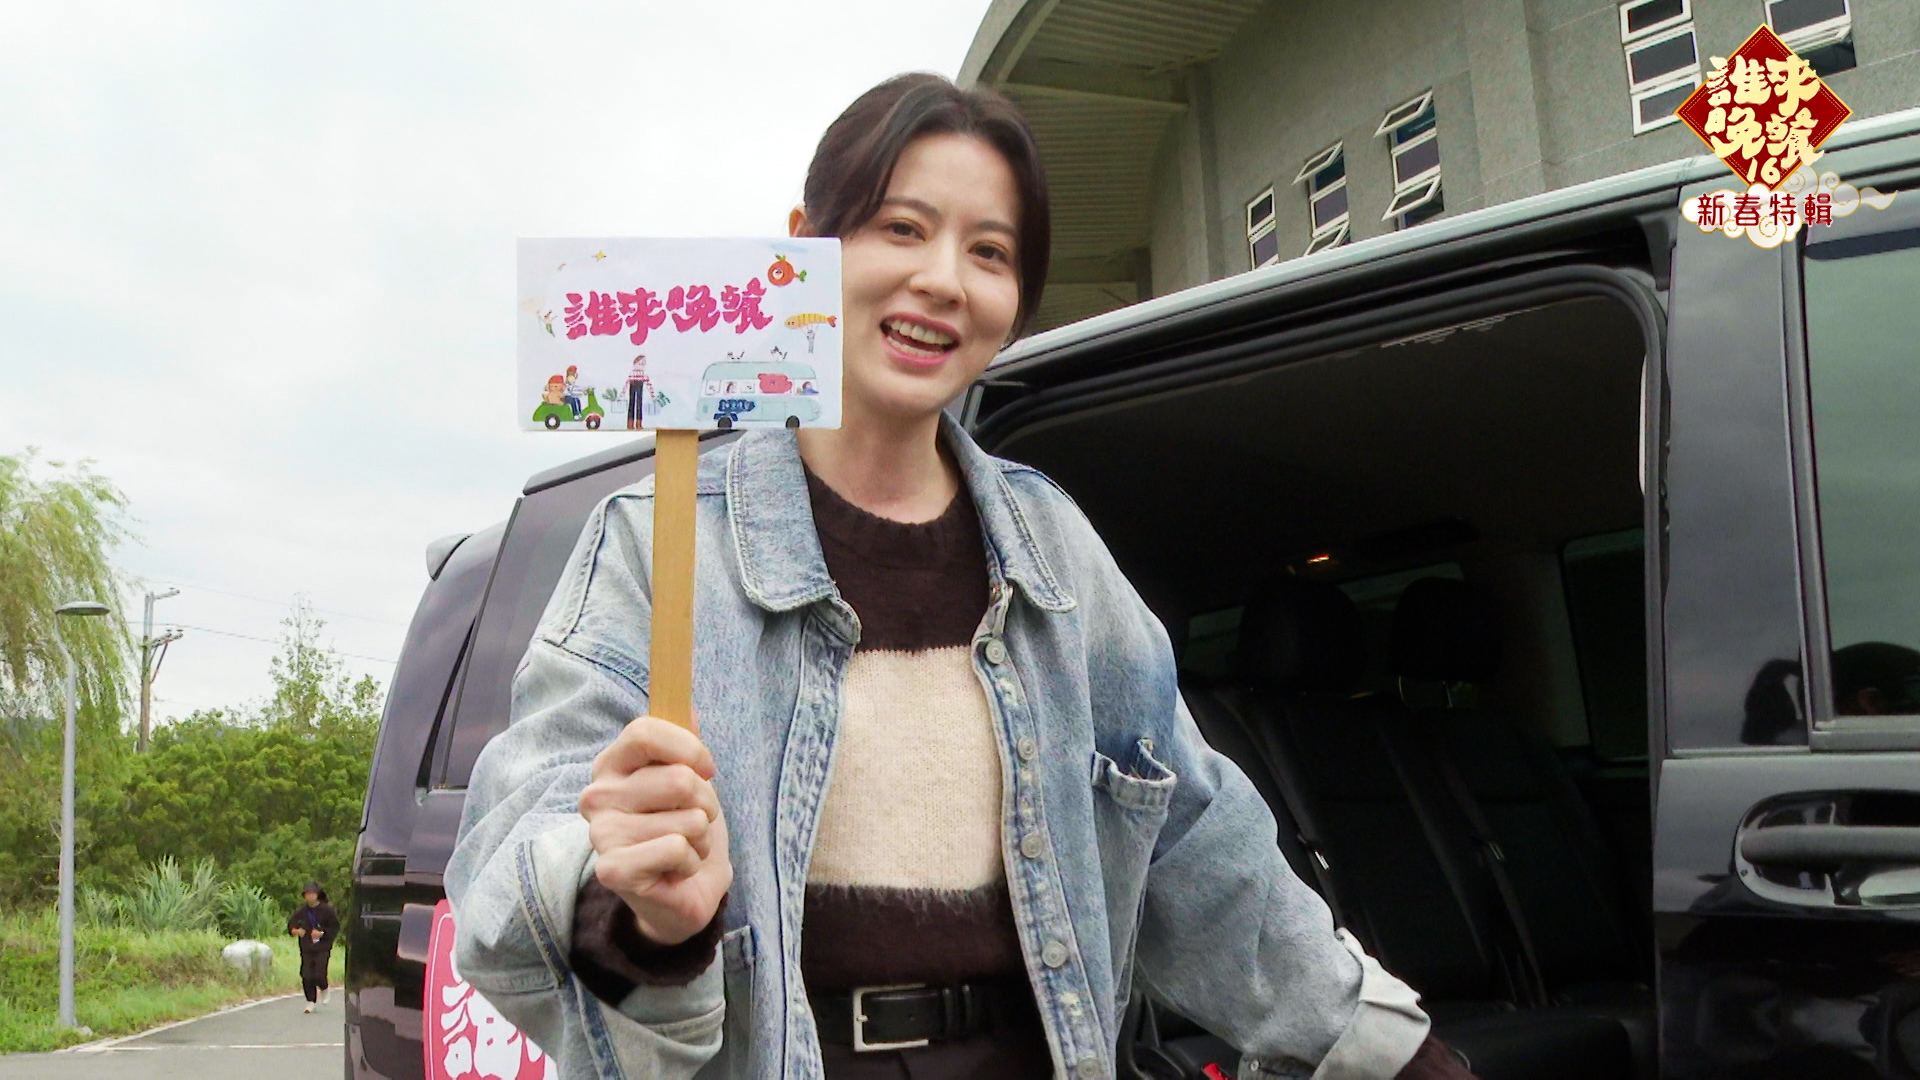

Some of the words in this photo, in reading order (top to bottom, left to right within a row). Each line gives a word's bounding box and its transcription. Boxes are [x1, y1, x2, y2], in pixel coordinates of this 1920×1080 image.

[564, 277, 774, 346] 誰來晚餐
[441, 950, 559, 1080] 誰
